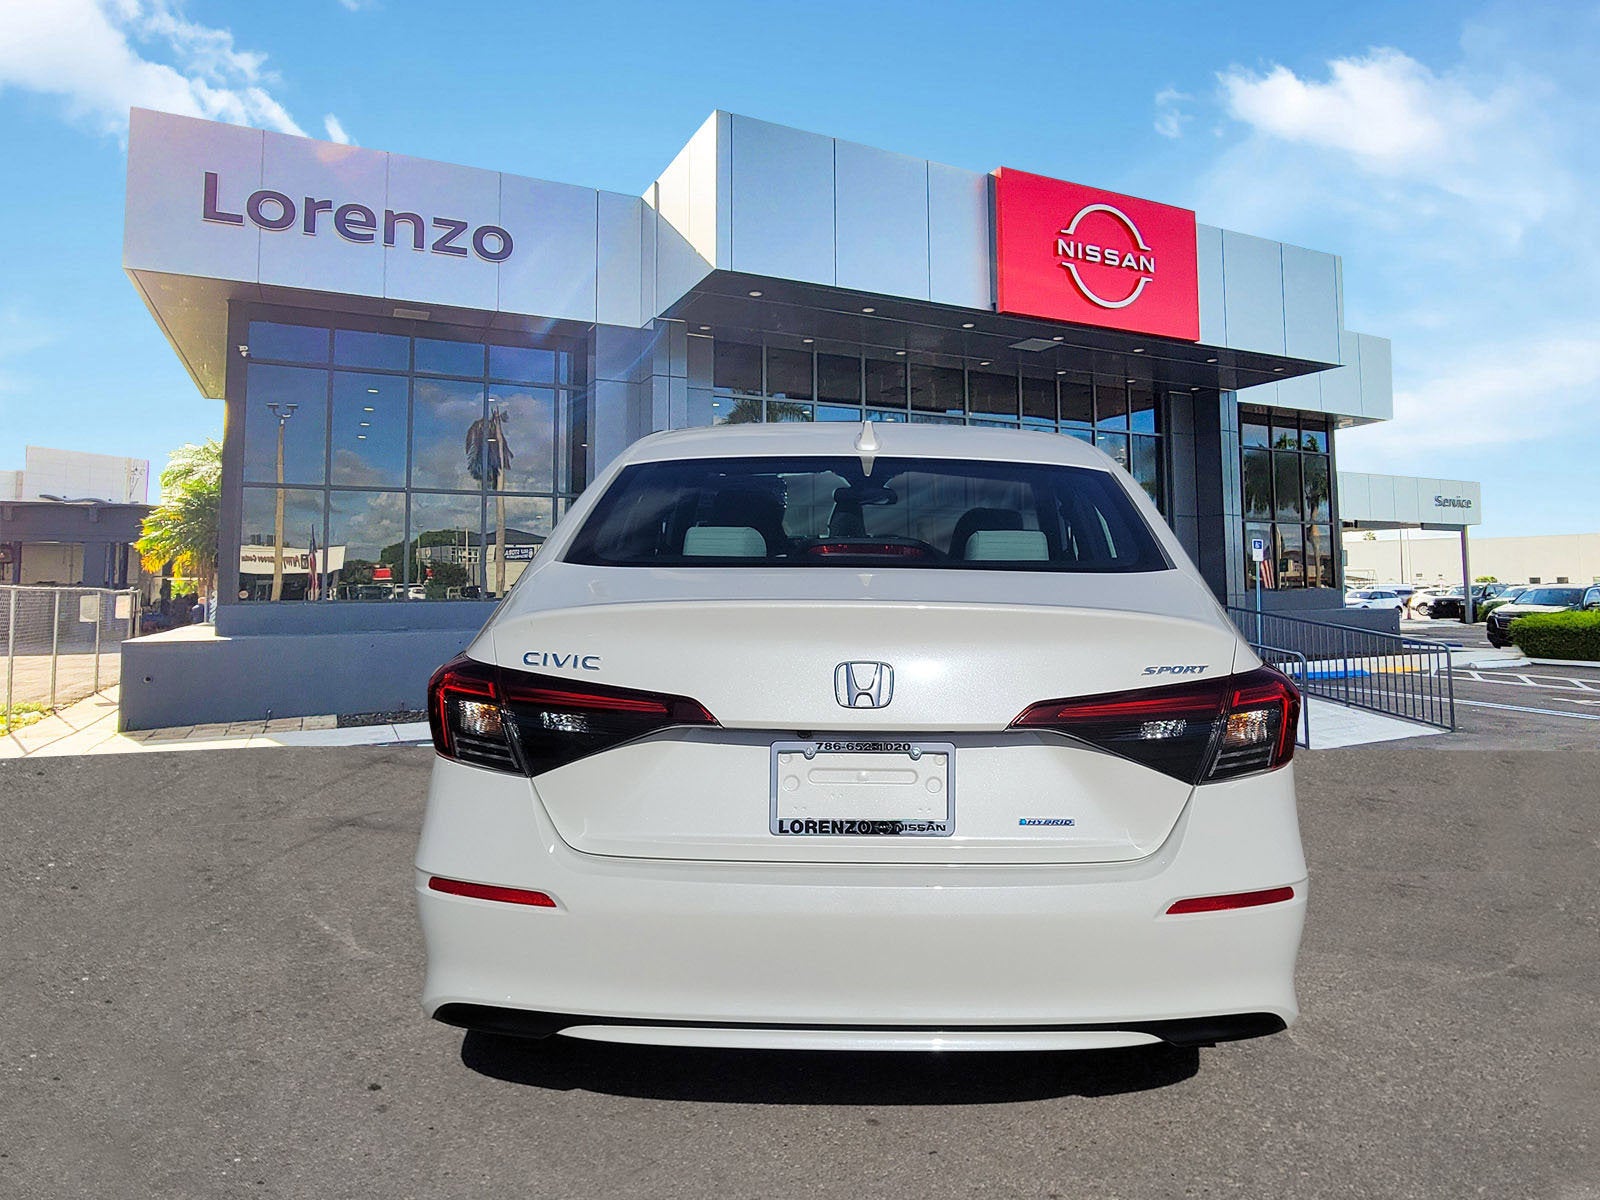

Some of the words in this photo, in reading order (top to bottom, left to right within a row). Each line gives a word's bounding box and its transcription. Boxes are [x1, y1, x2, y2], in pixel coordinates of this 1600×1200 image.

[202, 171, 514, 262] Lorenzo
[1057, 238, 1156, 273] NISSAN
[1434, 495, 1472, 508] Service
[523, 651, 601, 671] CIVIC
[1141, 665, 1209, 676] SPORT
[778, 819, 872, 834] LORENZO
